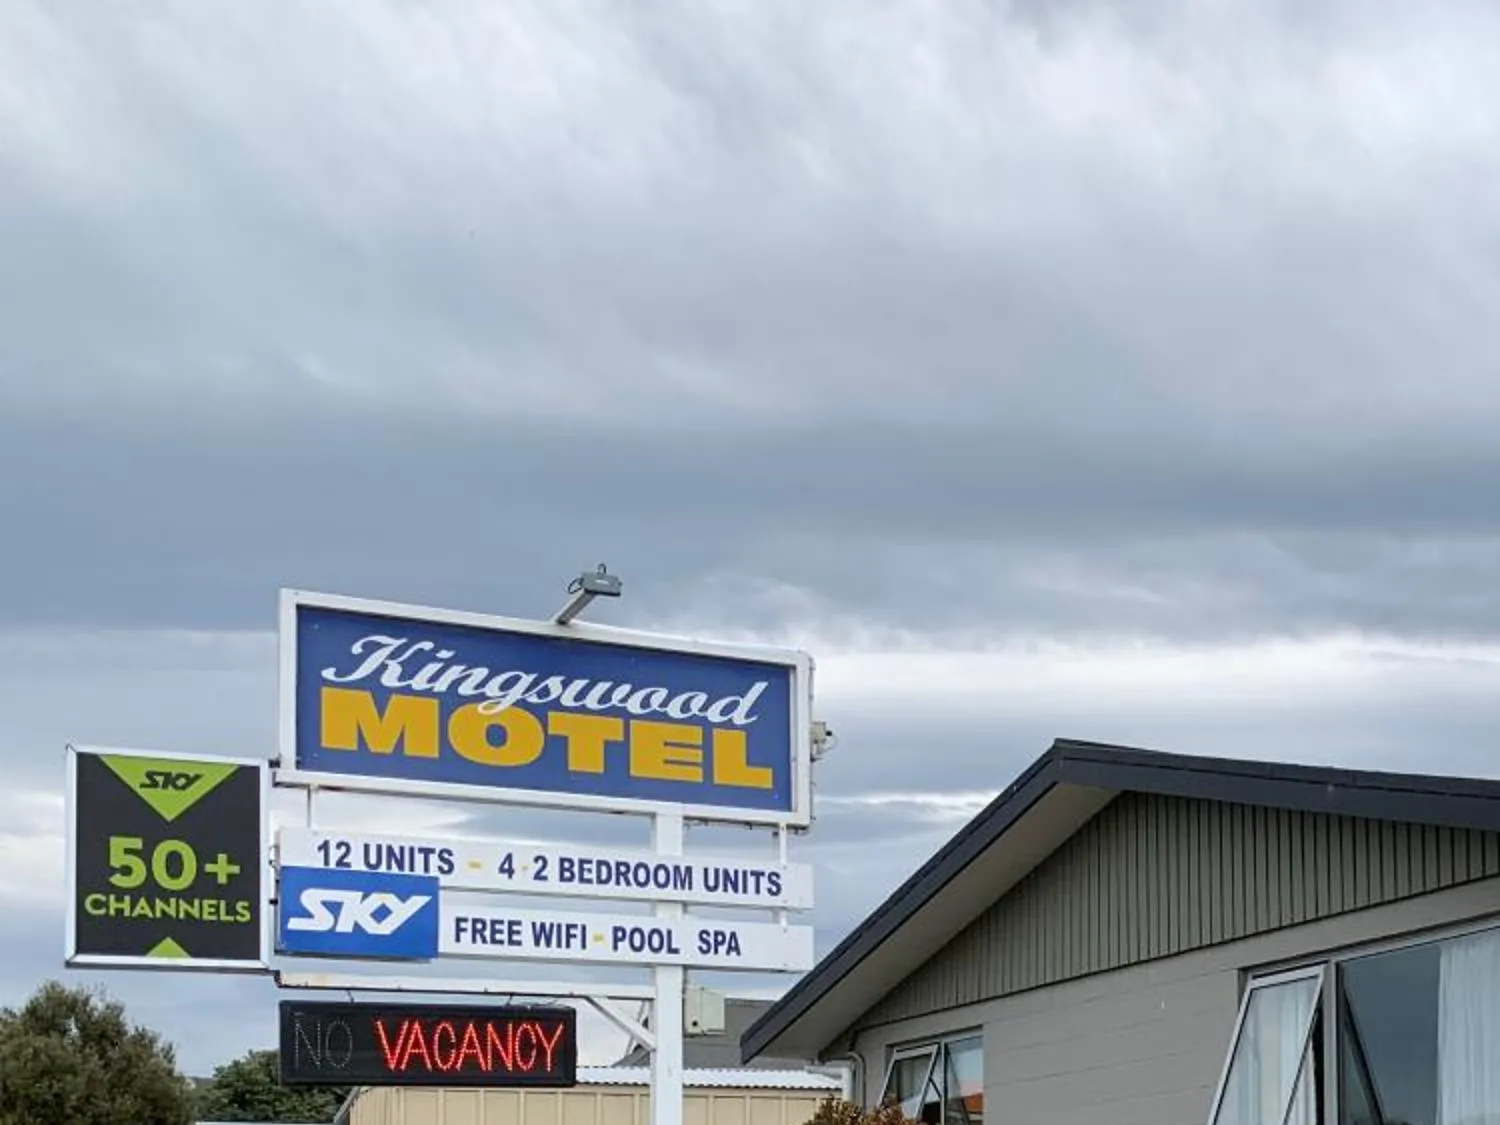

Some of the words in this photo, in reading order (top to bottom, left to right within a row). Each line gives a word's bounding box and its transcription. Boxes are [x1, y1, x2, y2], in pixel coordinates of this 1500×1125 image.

[321, 635, 768, 725] Kingswood
[320, 686, 773, 789] MOTEL
[139, 770, 205, 791] SKY
[108, 836, 241, 891] 50+
[317, 839, 352, 868] 12
[363, 843, 456, 875] UNITS
[498, 852, 515, 880] 4
[533, 855, 549, 882] 2
[558, 856, 693, 891] BEDROOM
[703, 867, 782, 897] UNITS
[84, 893, 251, 922] CHANNELS
[287, 888, 433, 935] SKY
[454, 917, 523, 946] FREE
[531, 921, 587, 950] WIFI
[612, 926, 681, 955] POOL
[697, 929, 742, 957] SPA
[294, 1013, 354, 1068] NO
[374, 1017, 565, 1074] VACANCY
